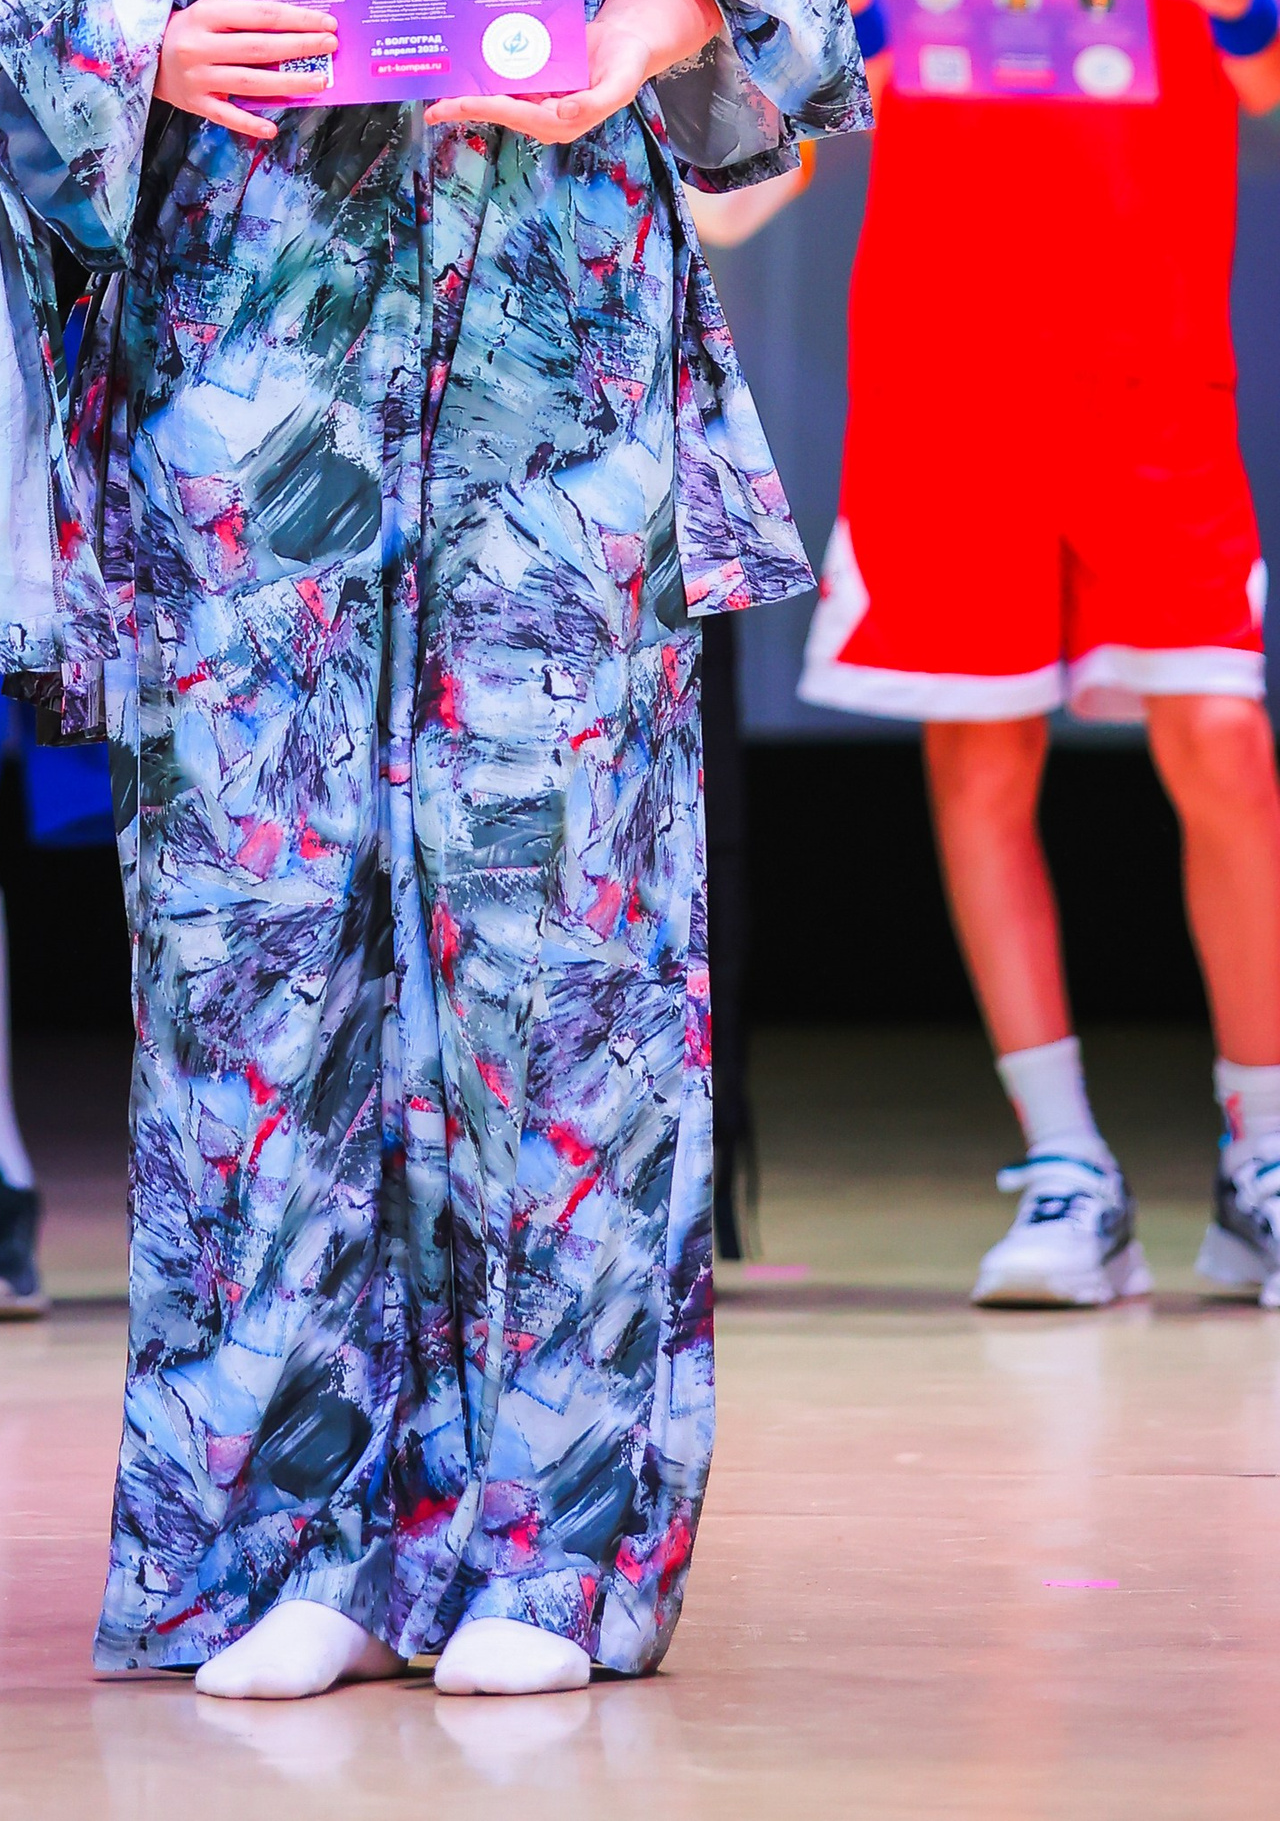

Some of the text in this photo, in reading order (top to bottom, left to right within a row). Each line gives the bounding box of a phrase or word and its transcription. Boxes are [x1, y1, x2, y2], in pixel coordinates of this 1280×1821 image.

[384, 34, 443, 46] ВОЛГОГРАД
[371, 47, 382, 56] 26
[383, 47, 417, 56] апреля
[417, 44, 439, 54] 2025
[378, 63, 442, 73] art-kompas.ru
